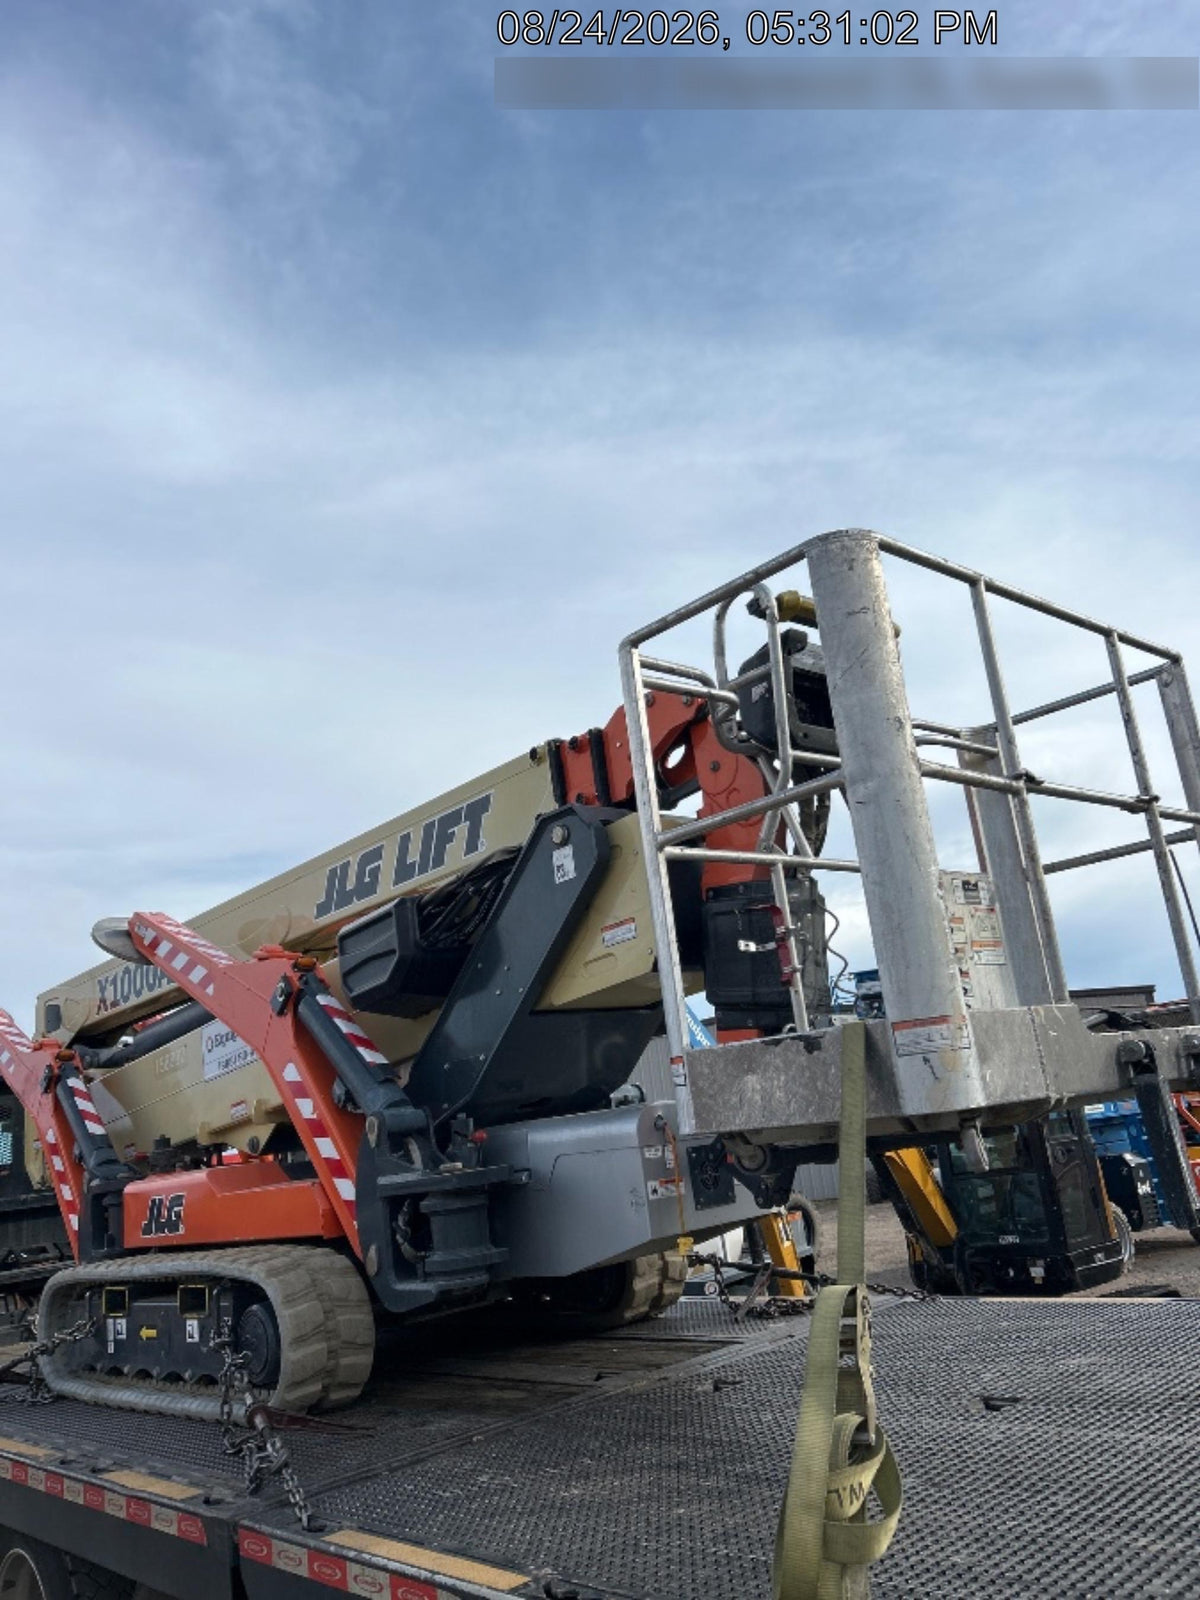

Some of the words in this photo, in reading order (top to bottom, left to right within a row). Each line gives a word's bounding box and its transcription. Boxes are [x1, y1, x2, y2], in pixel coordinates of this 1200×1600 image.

[314, 841, 385, 921] JLG
[391, 790, 495, 889] LIFT
[96, 963, 175, 1016] X1000A
[140, 1192, 186, 1238] JLG
